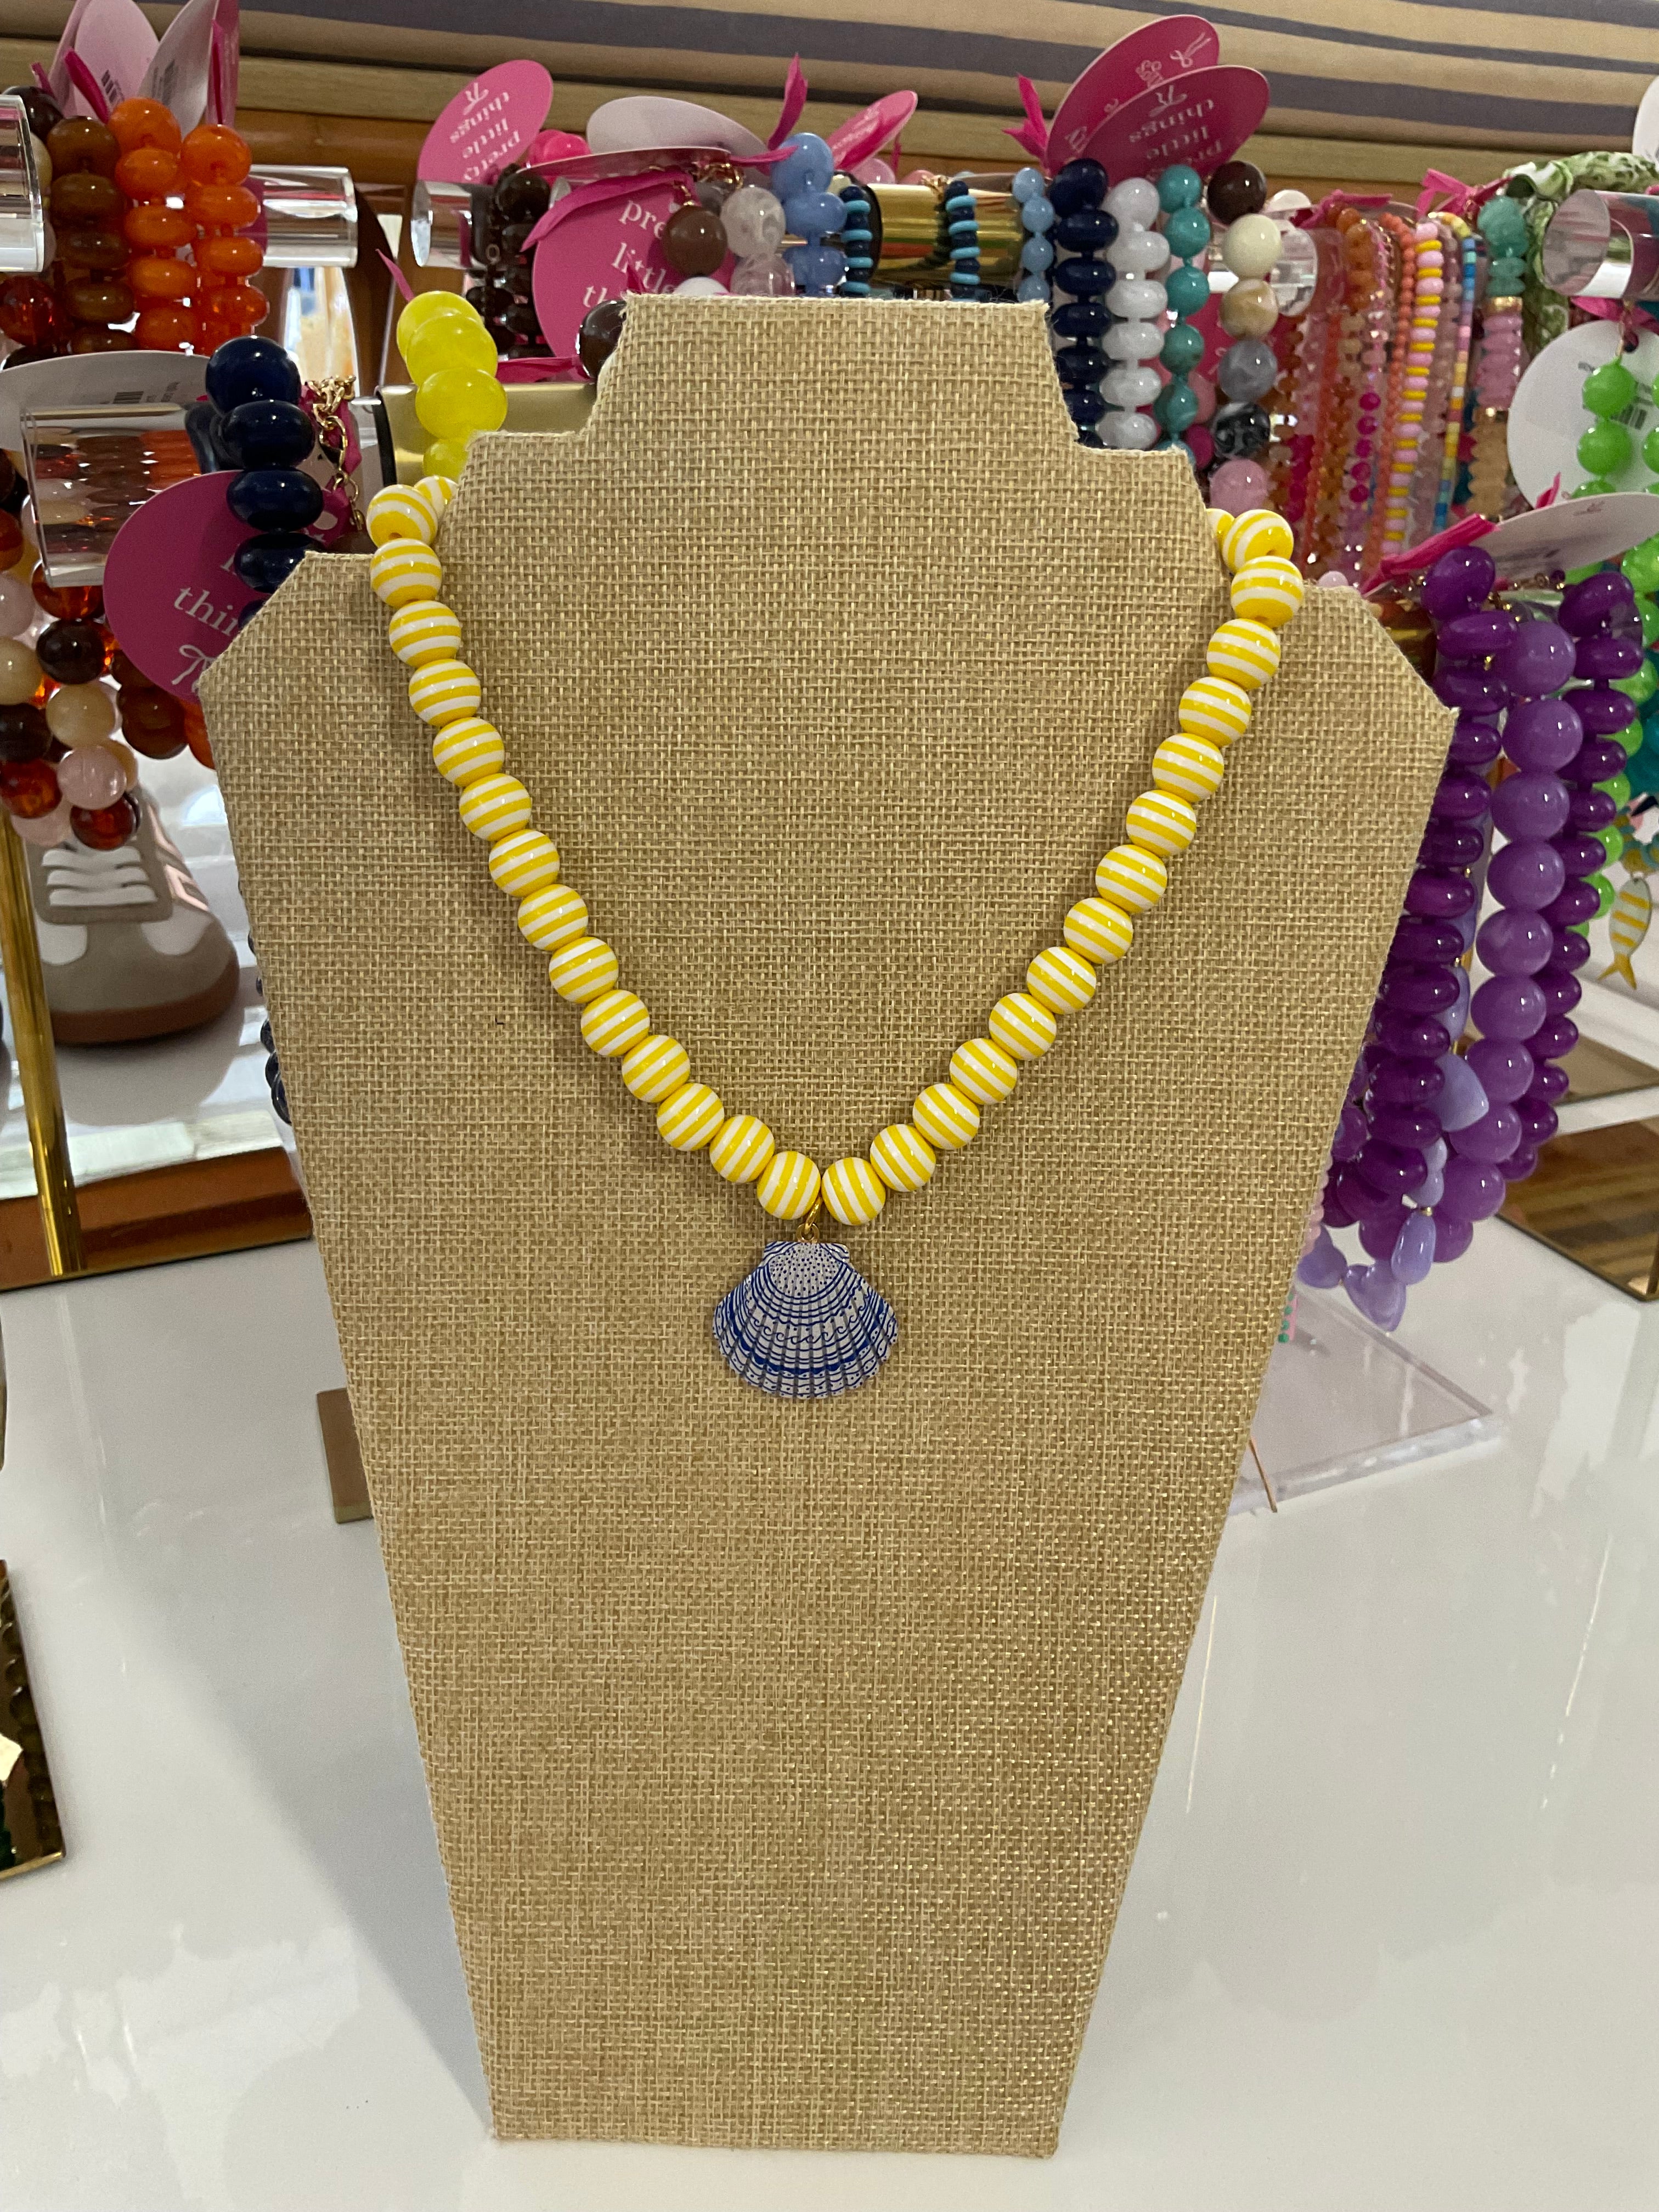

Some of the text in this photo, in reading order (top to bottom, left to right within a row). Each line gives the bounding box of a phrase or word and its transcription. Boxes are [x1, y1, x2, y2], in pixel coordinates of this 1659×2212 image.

[450, 92, 510, 143] things
[462, 118, 509, 158] little
[618, 200, 667, 239] pre
[173, 586, 239, 636] thi
